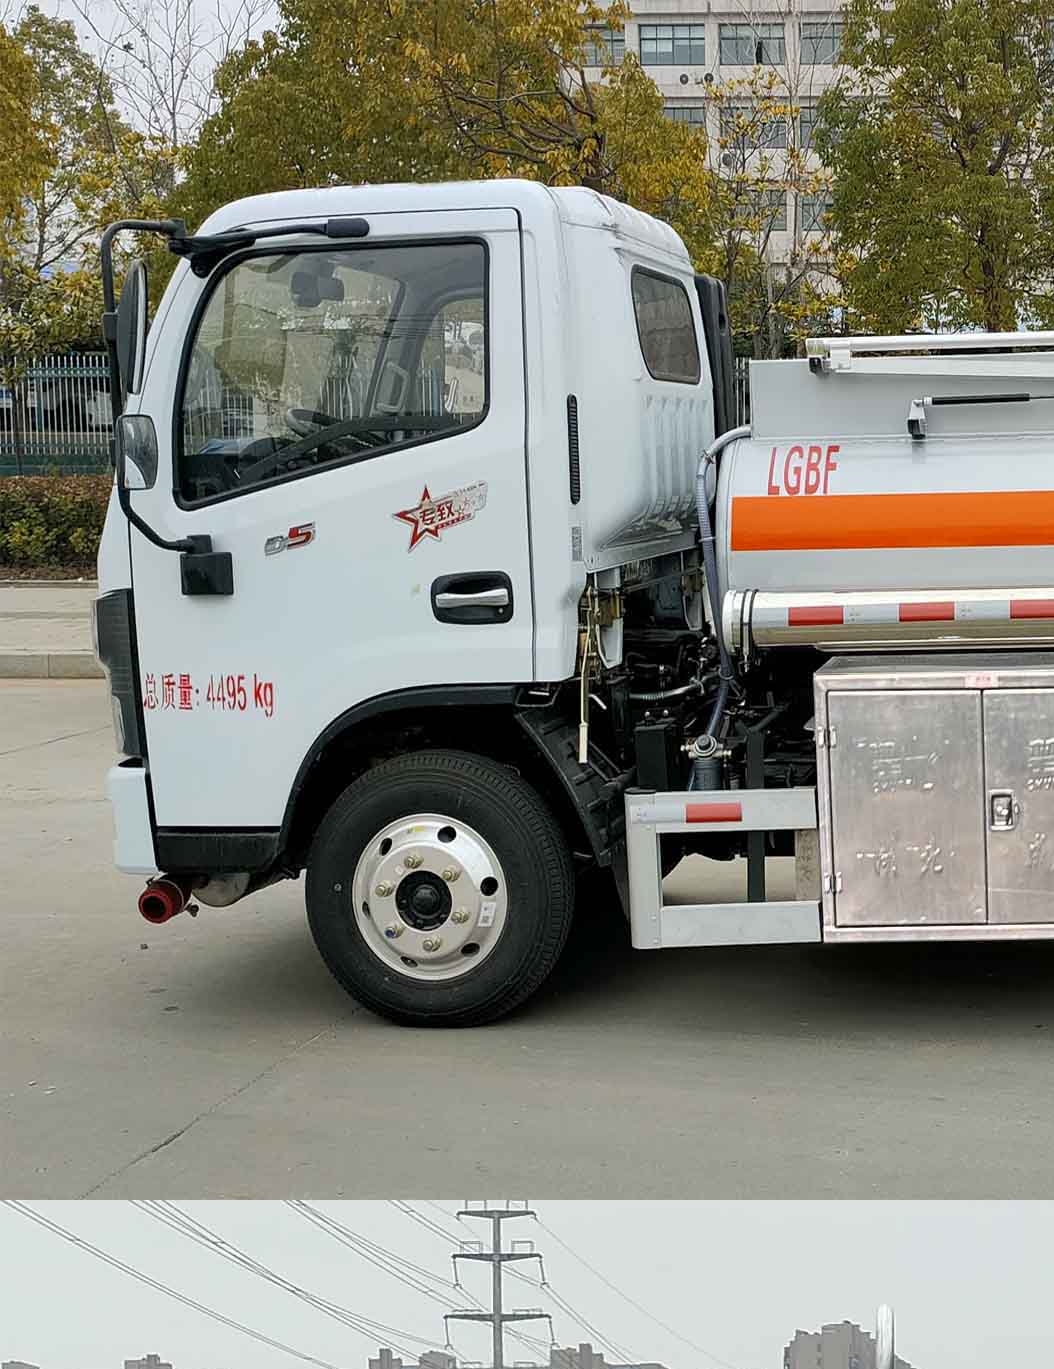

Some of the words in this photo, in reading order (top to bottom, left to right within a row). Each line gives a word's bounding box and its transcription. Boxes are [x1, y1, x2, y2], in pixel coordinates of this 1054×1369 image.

[768, 445, 840, 496] LGBF
[206, 674, 247, 712] 4495
[253, 673, 274, 718] kg
